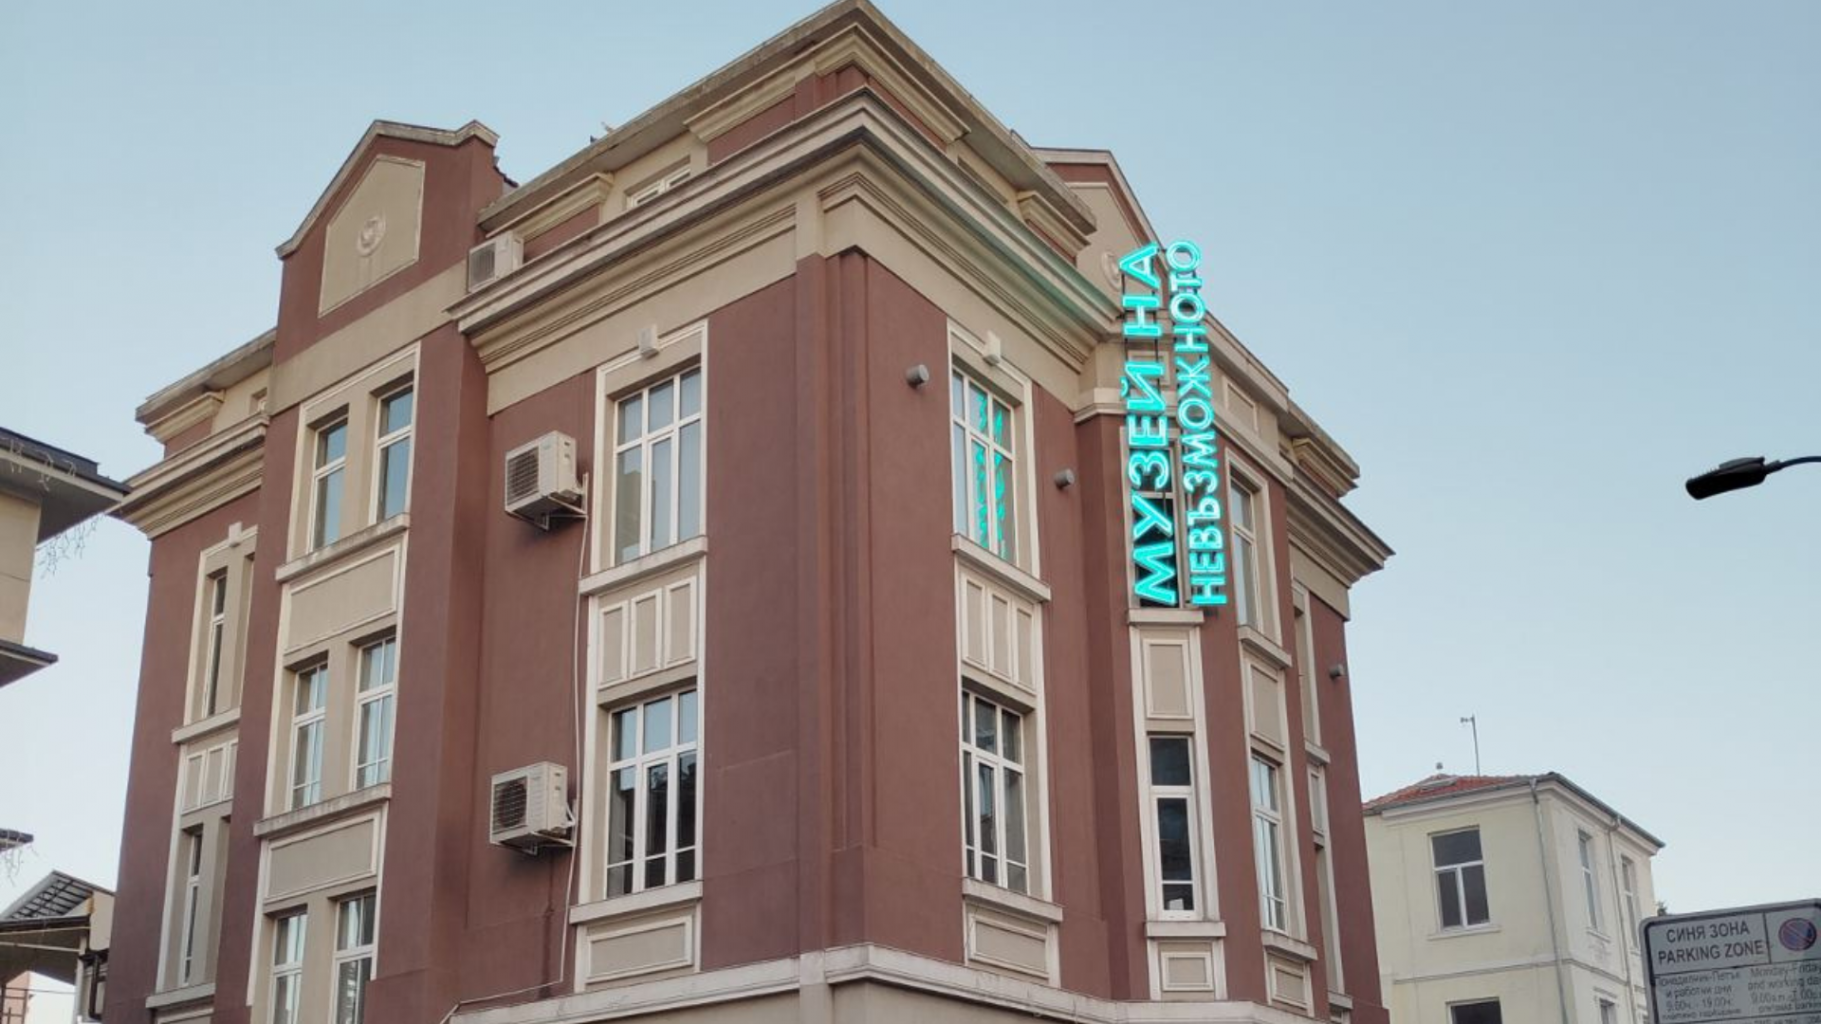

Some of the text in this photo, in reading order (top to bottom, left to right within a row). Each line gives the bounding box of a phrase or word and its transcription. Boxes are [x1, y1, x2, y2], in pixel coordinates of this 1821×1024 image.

[1118, 240, 1176, 606] МУЗЕЙ НА
[1165, 240, 1228, 607] НЕВЪЗМОЖНОТО
[1658, 940, 1765, 965] PARKING ZONE
[1666, 920, 1750, 943] СИНЯ ЗОНА
